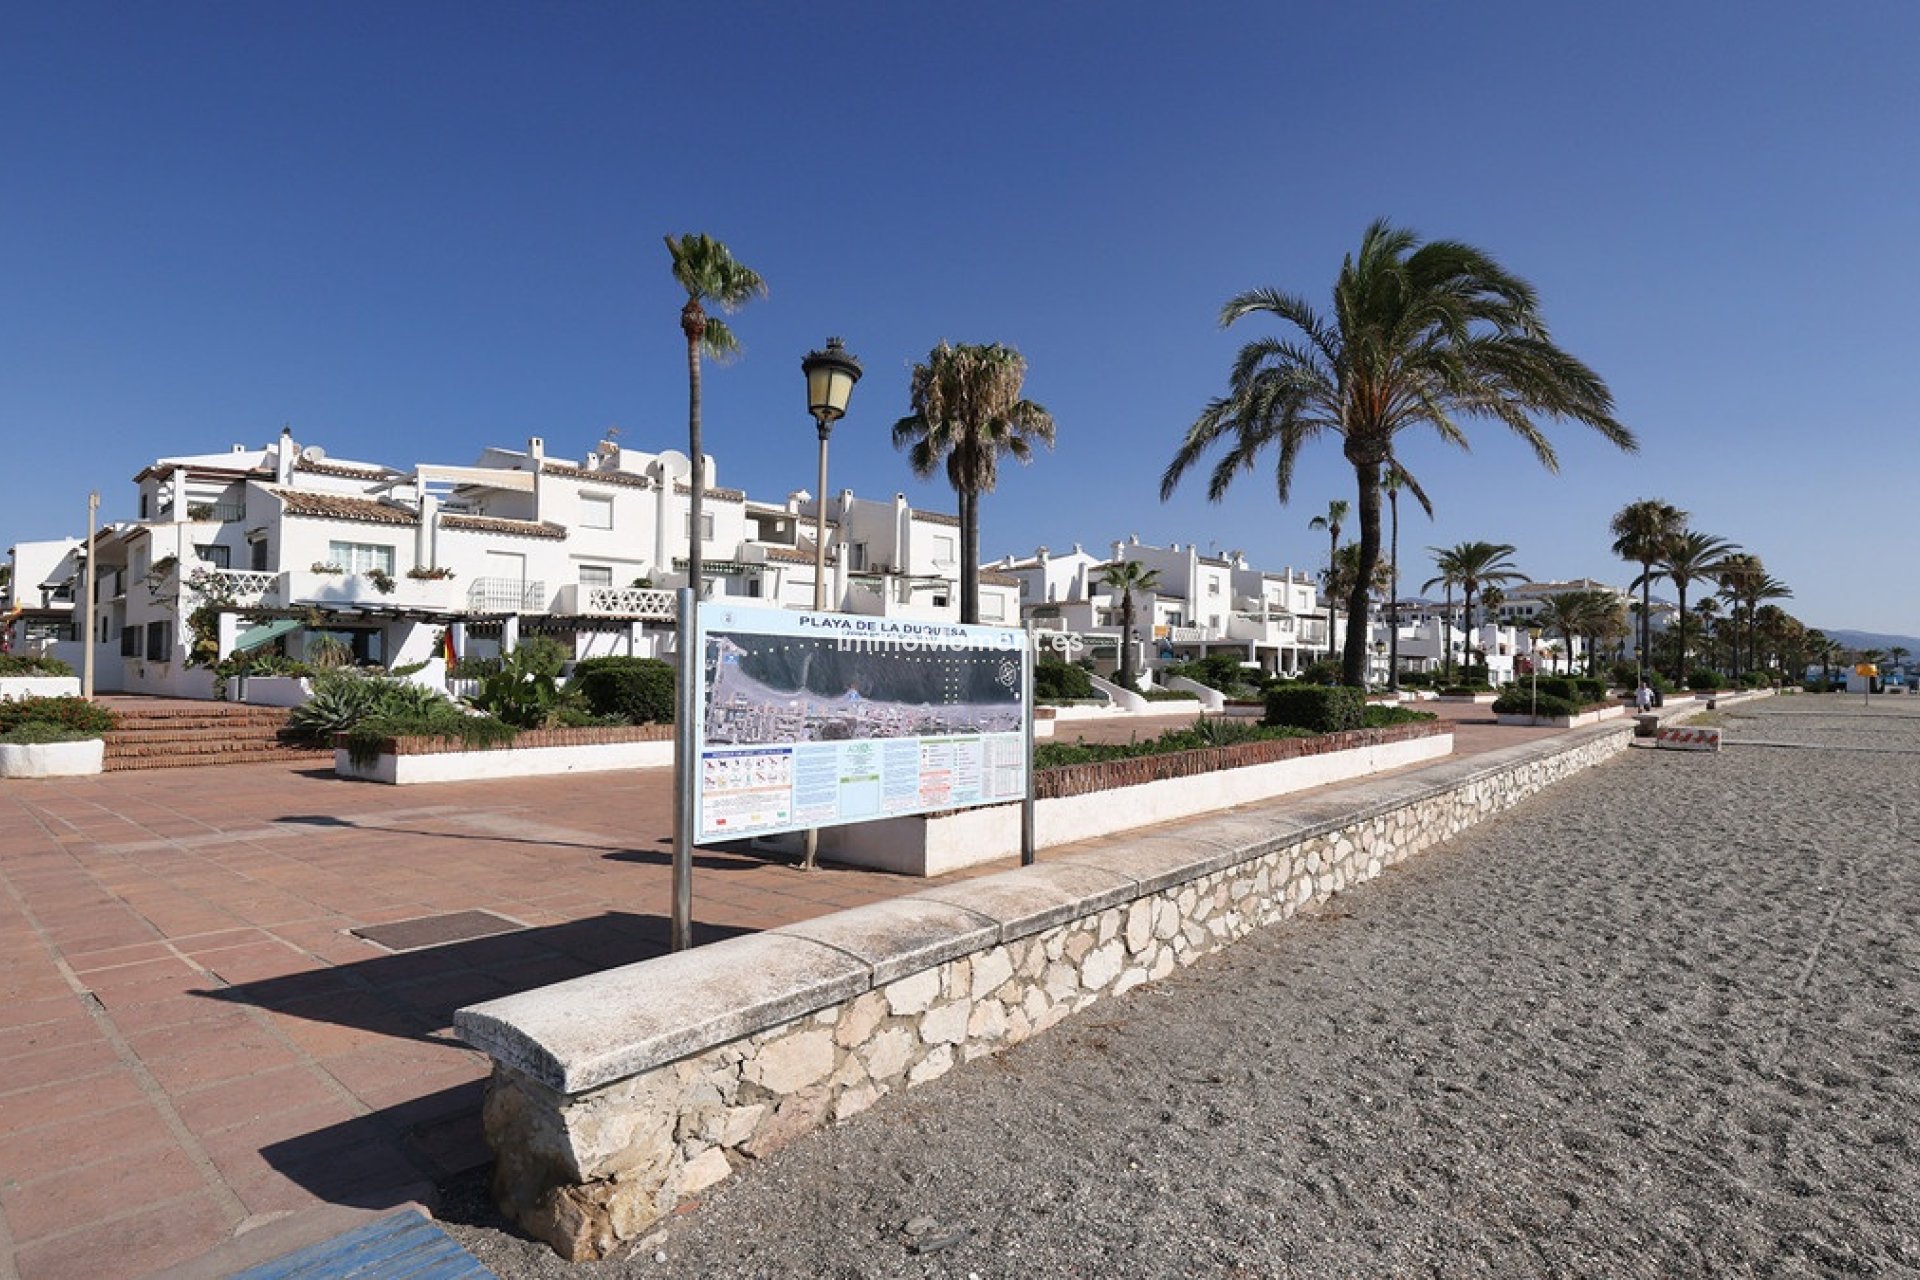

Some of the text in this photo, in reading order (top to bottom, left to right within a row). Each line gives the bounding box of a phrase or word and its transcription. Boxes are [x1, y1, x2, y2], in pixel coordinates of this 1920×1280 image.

[799, 615, 852, 630] PLAYA
[856, 620, 877, 632] DE
[881, 622, 900, 633] LA
[903, 624, 968, 638] DUQUESA
